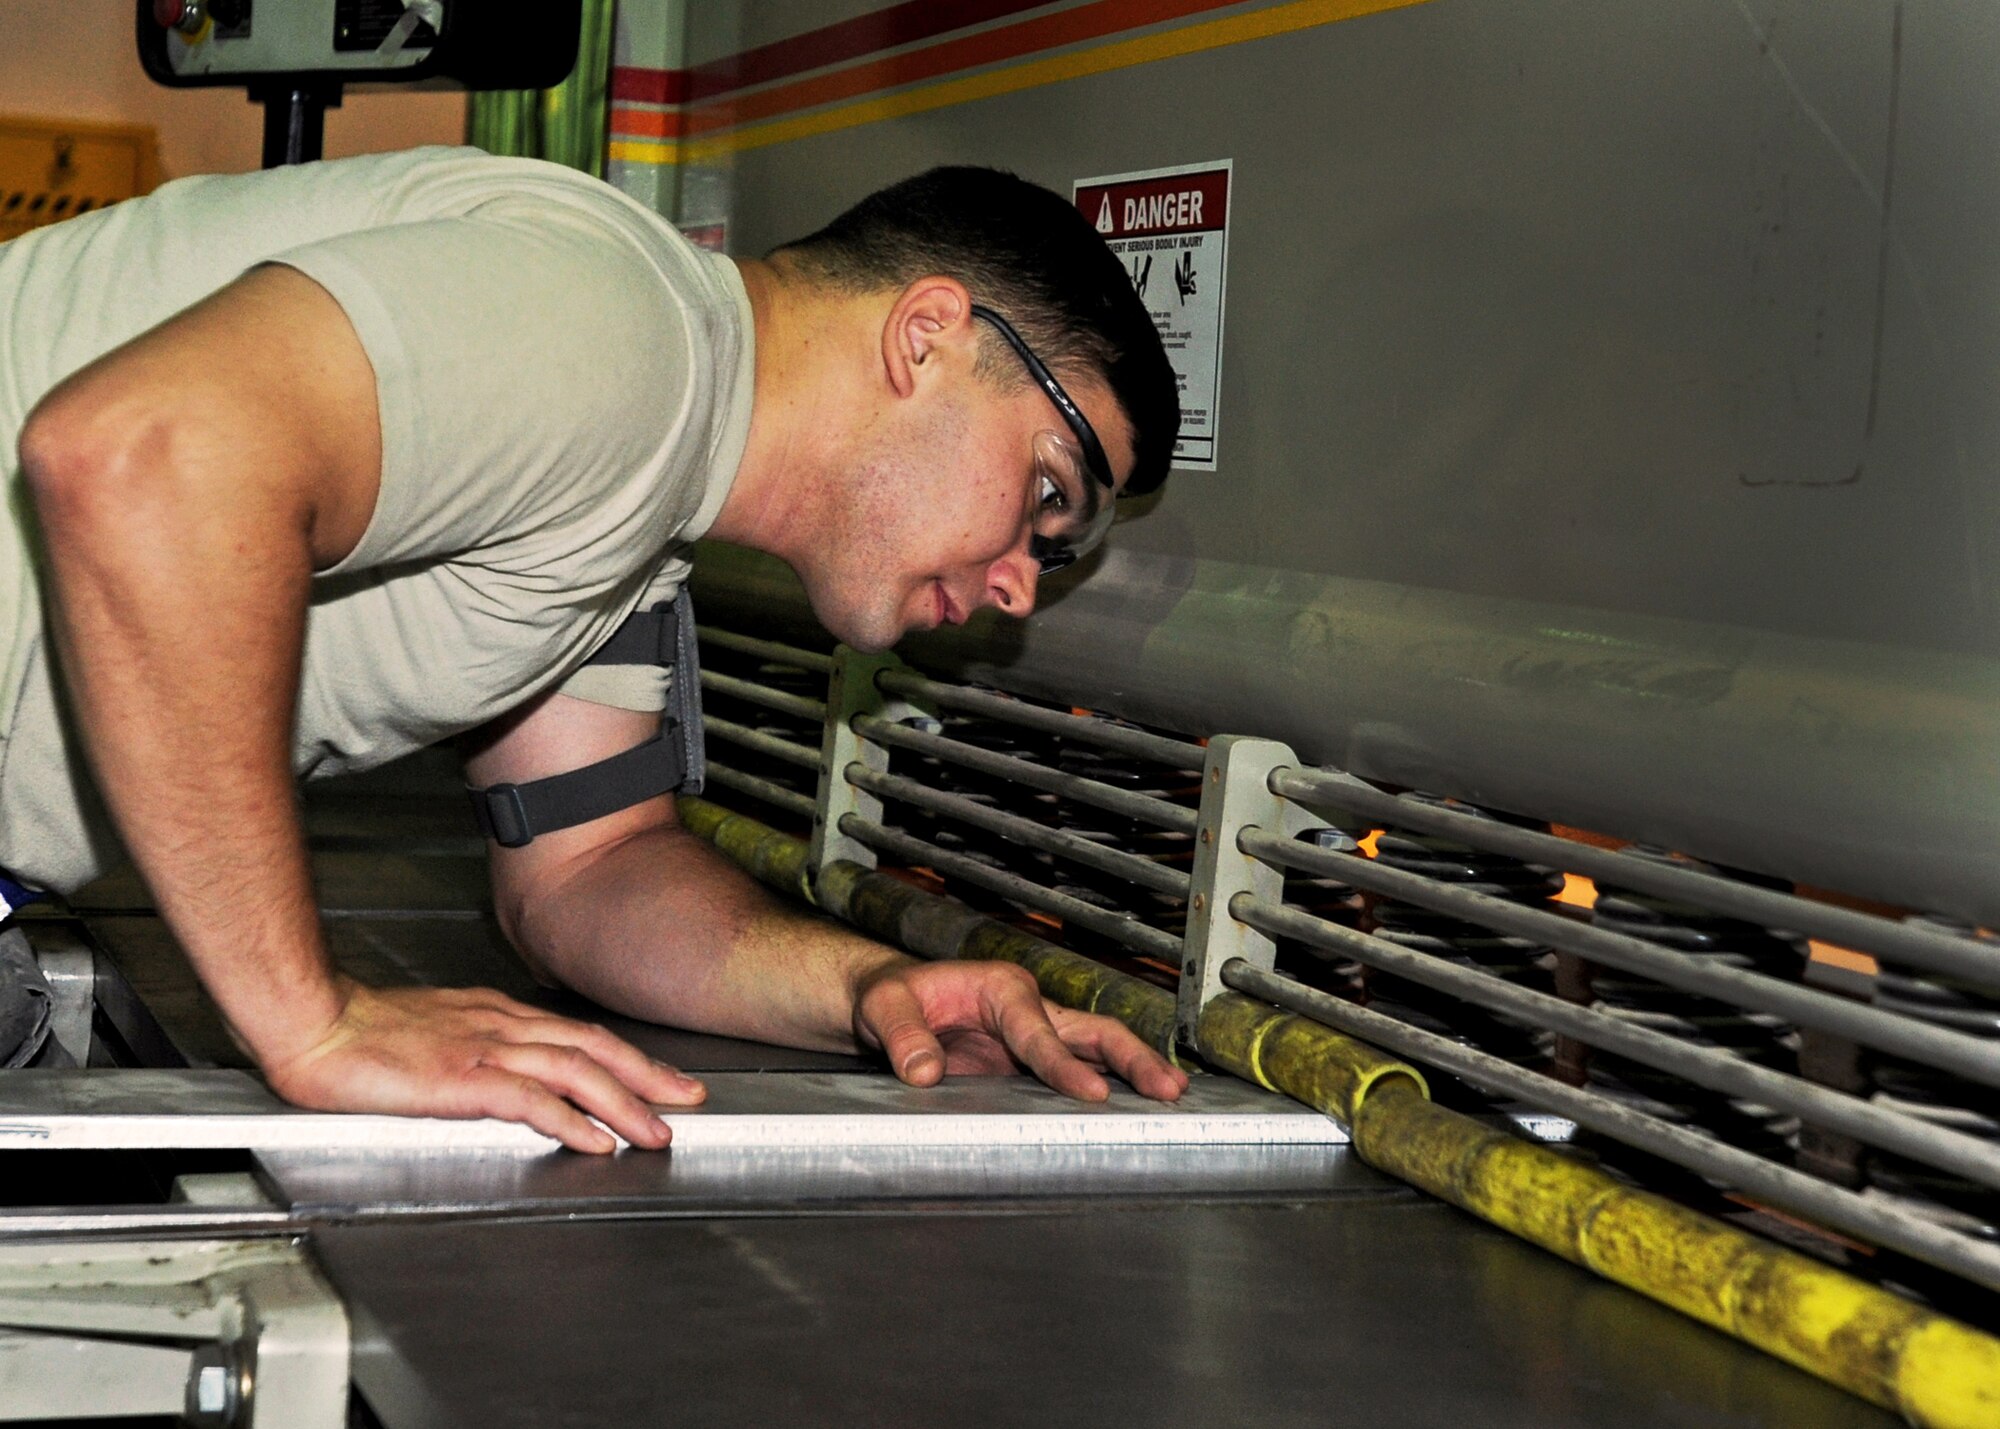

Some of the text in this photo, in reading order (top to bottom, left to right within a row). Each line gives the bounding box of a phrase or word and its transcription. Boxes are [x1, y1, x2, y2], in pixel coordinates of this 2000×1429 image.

[1124, 190, 1203, 231] DANGER
[1127, 239, 1154, 252] SERIOUS
[1155, 237, 1178, 250] BODILY
[1179, 235, 1204, 248] INJURY
